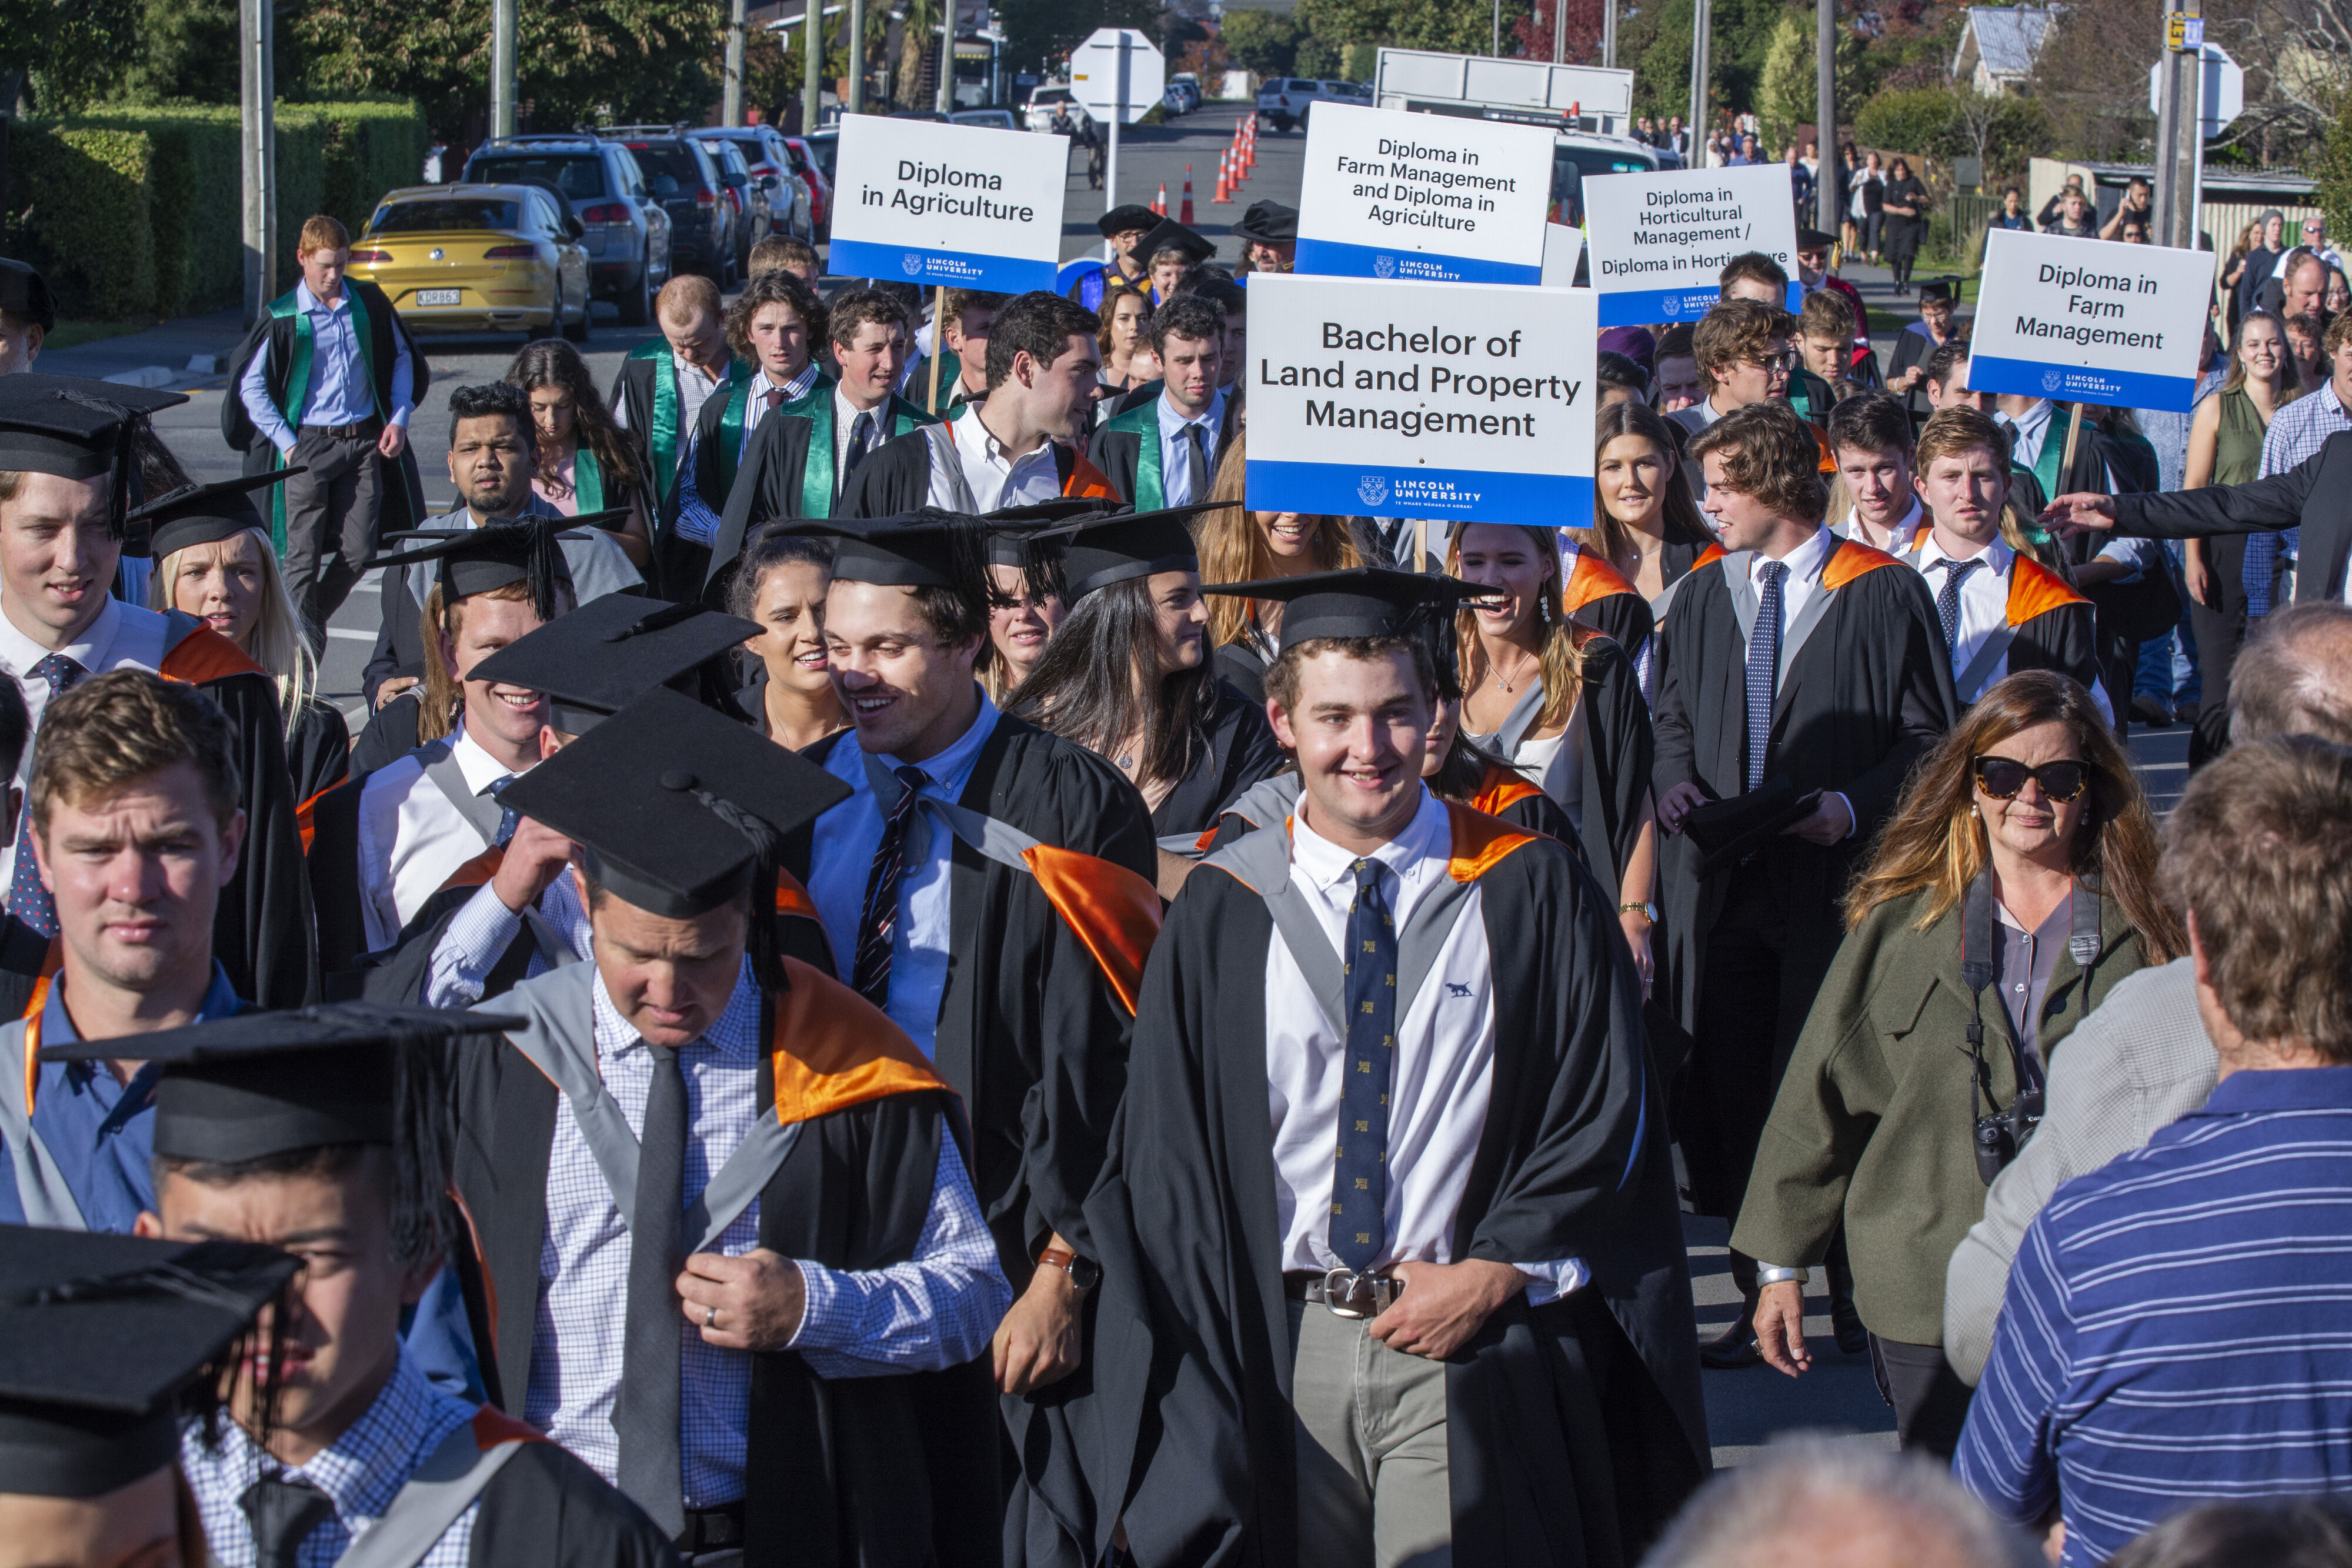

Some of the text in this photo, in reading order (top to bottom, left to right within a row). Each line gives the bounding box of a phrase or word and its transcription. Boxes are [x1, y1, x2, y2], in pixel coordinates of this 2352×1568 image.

[1379, 139, 1479, 166] Diploma in
[898, 160, 1002, 191] Diploma
[1337, 156, 1516, 192] Farm Management
[862, 184, 1033, 222] in Agriculture
[1353, 183, 1494, 212] and Diploma in
[1646, 187, 1733, 208] Diploma in
[1368, 205, 1475, 232] Agriculture
[1640, 205, 1742, 226] Horticultural
[1634, 223, 1751, 245] Management /
[926, 264, 983, 275] UNIVERSITY
[927, 258, 966, 267] LINCOLN
[1400, 260, 1442, 271] LINCOLN
[1400, 268, 1460, 280] UNIVERSITY
[1602, 252, 1787, 276] Diploma in Hortire
[2039, 264, 2157, 295] Diploma in
[418, 292, 458, 302] KDR863
[2069, 294, 2124, 318] Farm
[1323, 322, 1522, 358] Bachelor of
[2016, 316, 2164, 349] Management
[1262, 359, 1582, 406] Land and Property
[2066, 374, 2105, 383] LINCOLN
[2066, 381, 2121, 392] UNIVERSITY
[1306, 399, 1535, 438] Management
[1395, 480, 1454, 491] LINCOLN
[1395, 489, 1481, 501] UNIVERSITY
